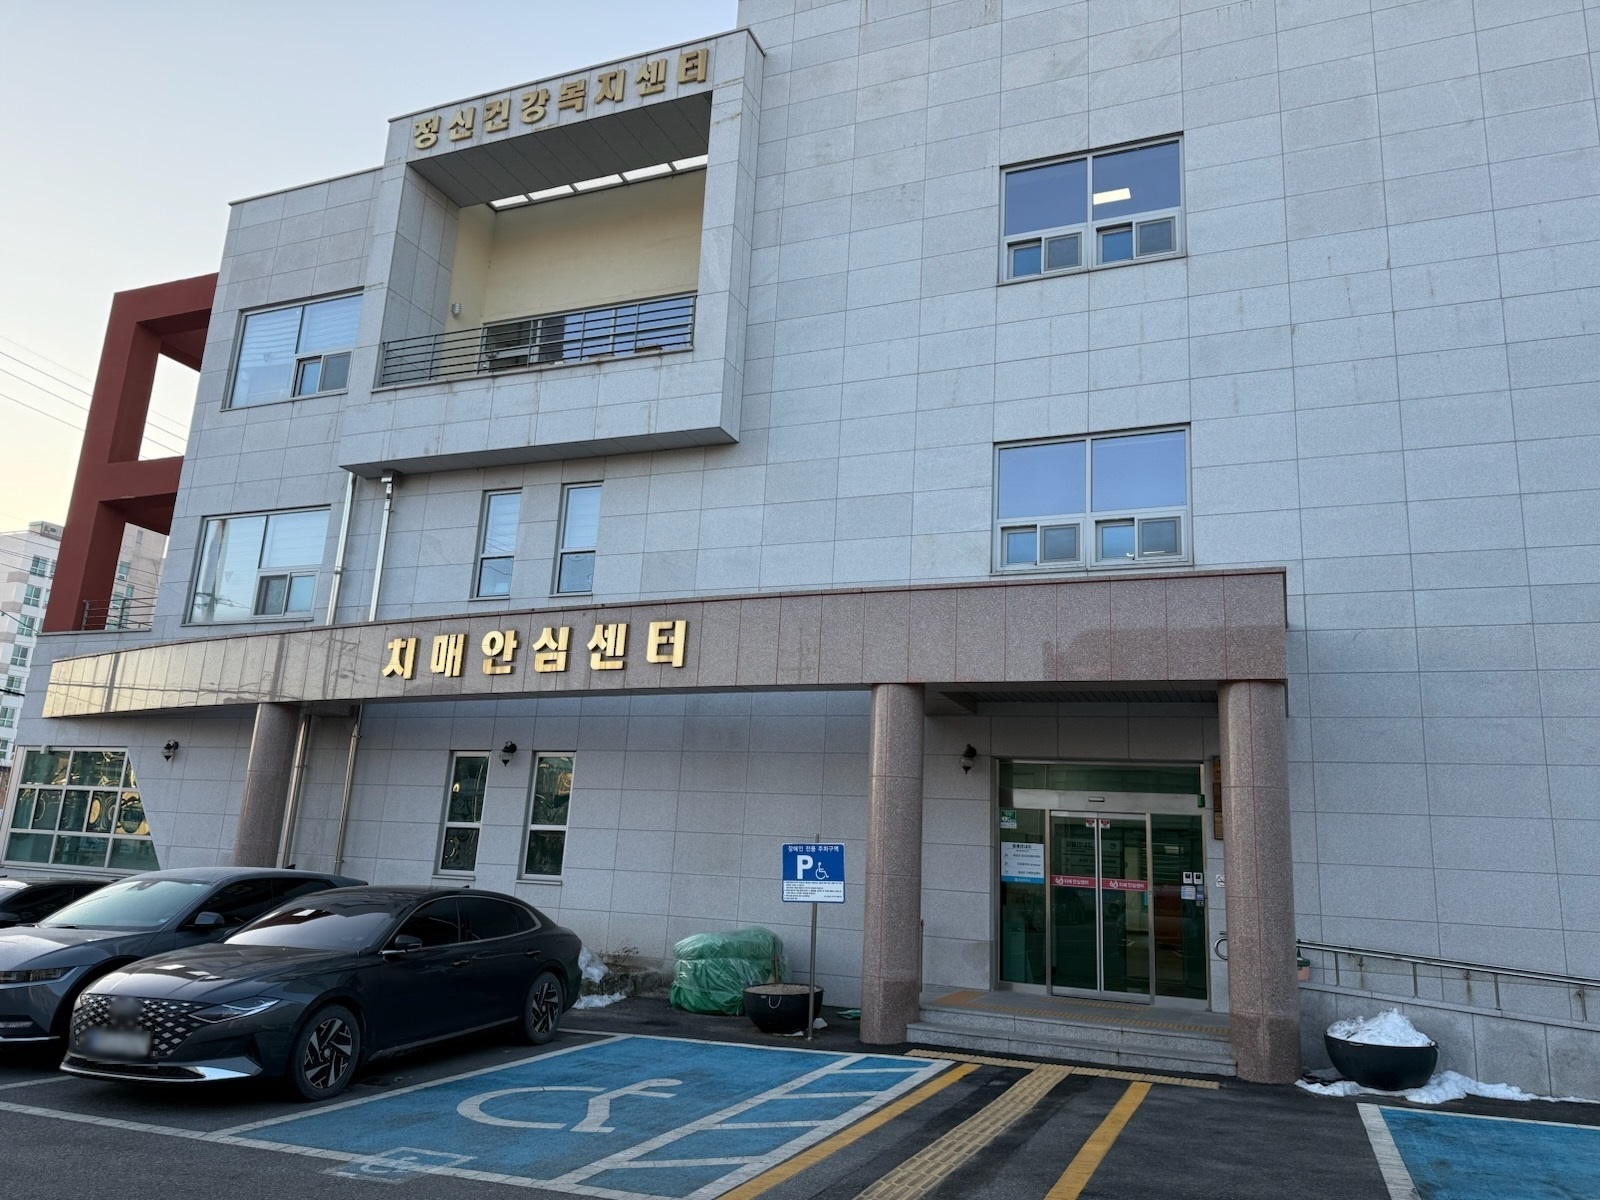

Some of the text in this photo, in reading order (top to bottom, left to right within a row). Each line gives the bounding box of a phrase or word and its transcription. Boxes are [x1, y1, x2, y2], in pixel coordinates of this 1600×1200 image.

[413, 48, 709, 150] 정신건강복지센터
[382, 620, 688, 680] 치매안심센터
[797, 855, 813, 879] P
